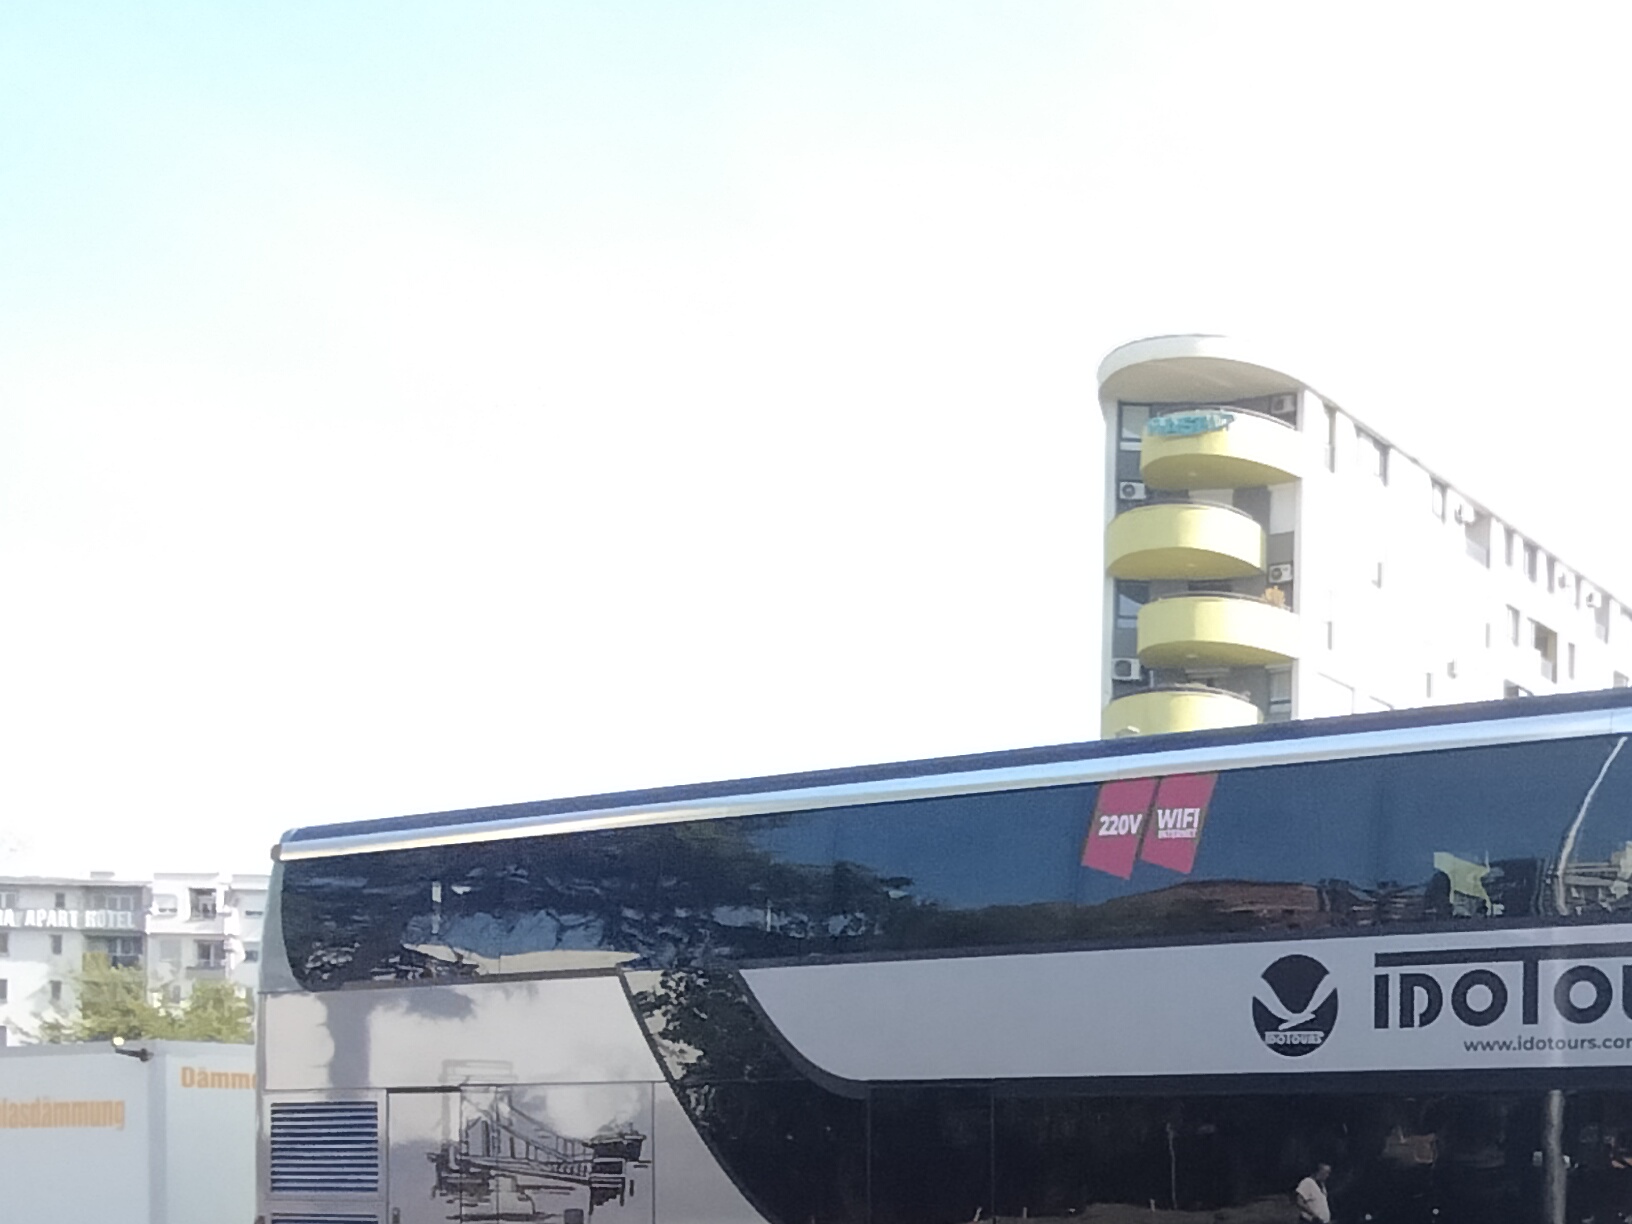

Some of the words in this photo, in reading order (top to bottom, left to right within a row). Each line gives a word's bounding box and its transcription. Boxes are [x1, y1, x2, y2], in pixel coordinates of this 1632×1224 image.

[1098, 813, 1143, 836] 220V
[1157, 807, 1201, 829] WIFI
[0, 908, 16, 927] A
[24, 908, 79, 928] APART
[0, 1094, 126, 1132] lasdämmung
